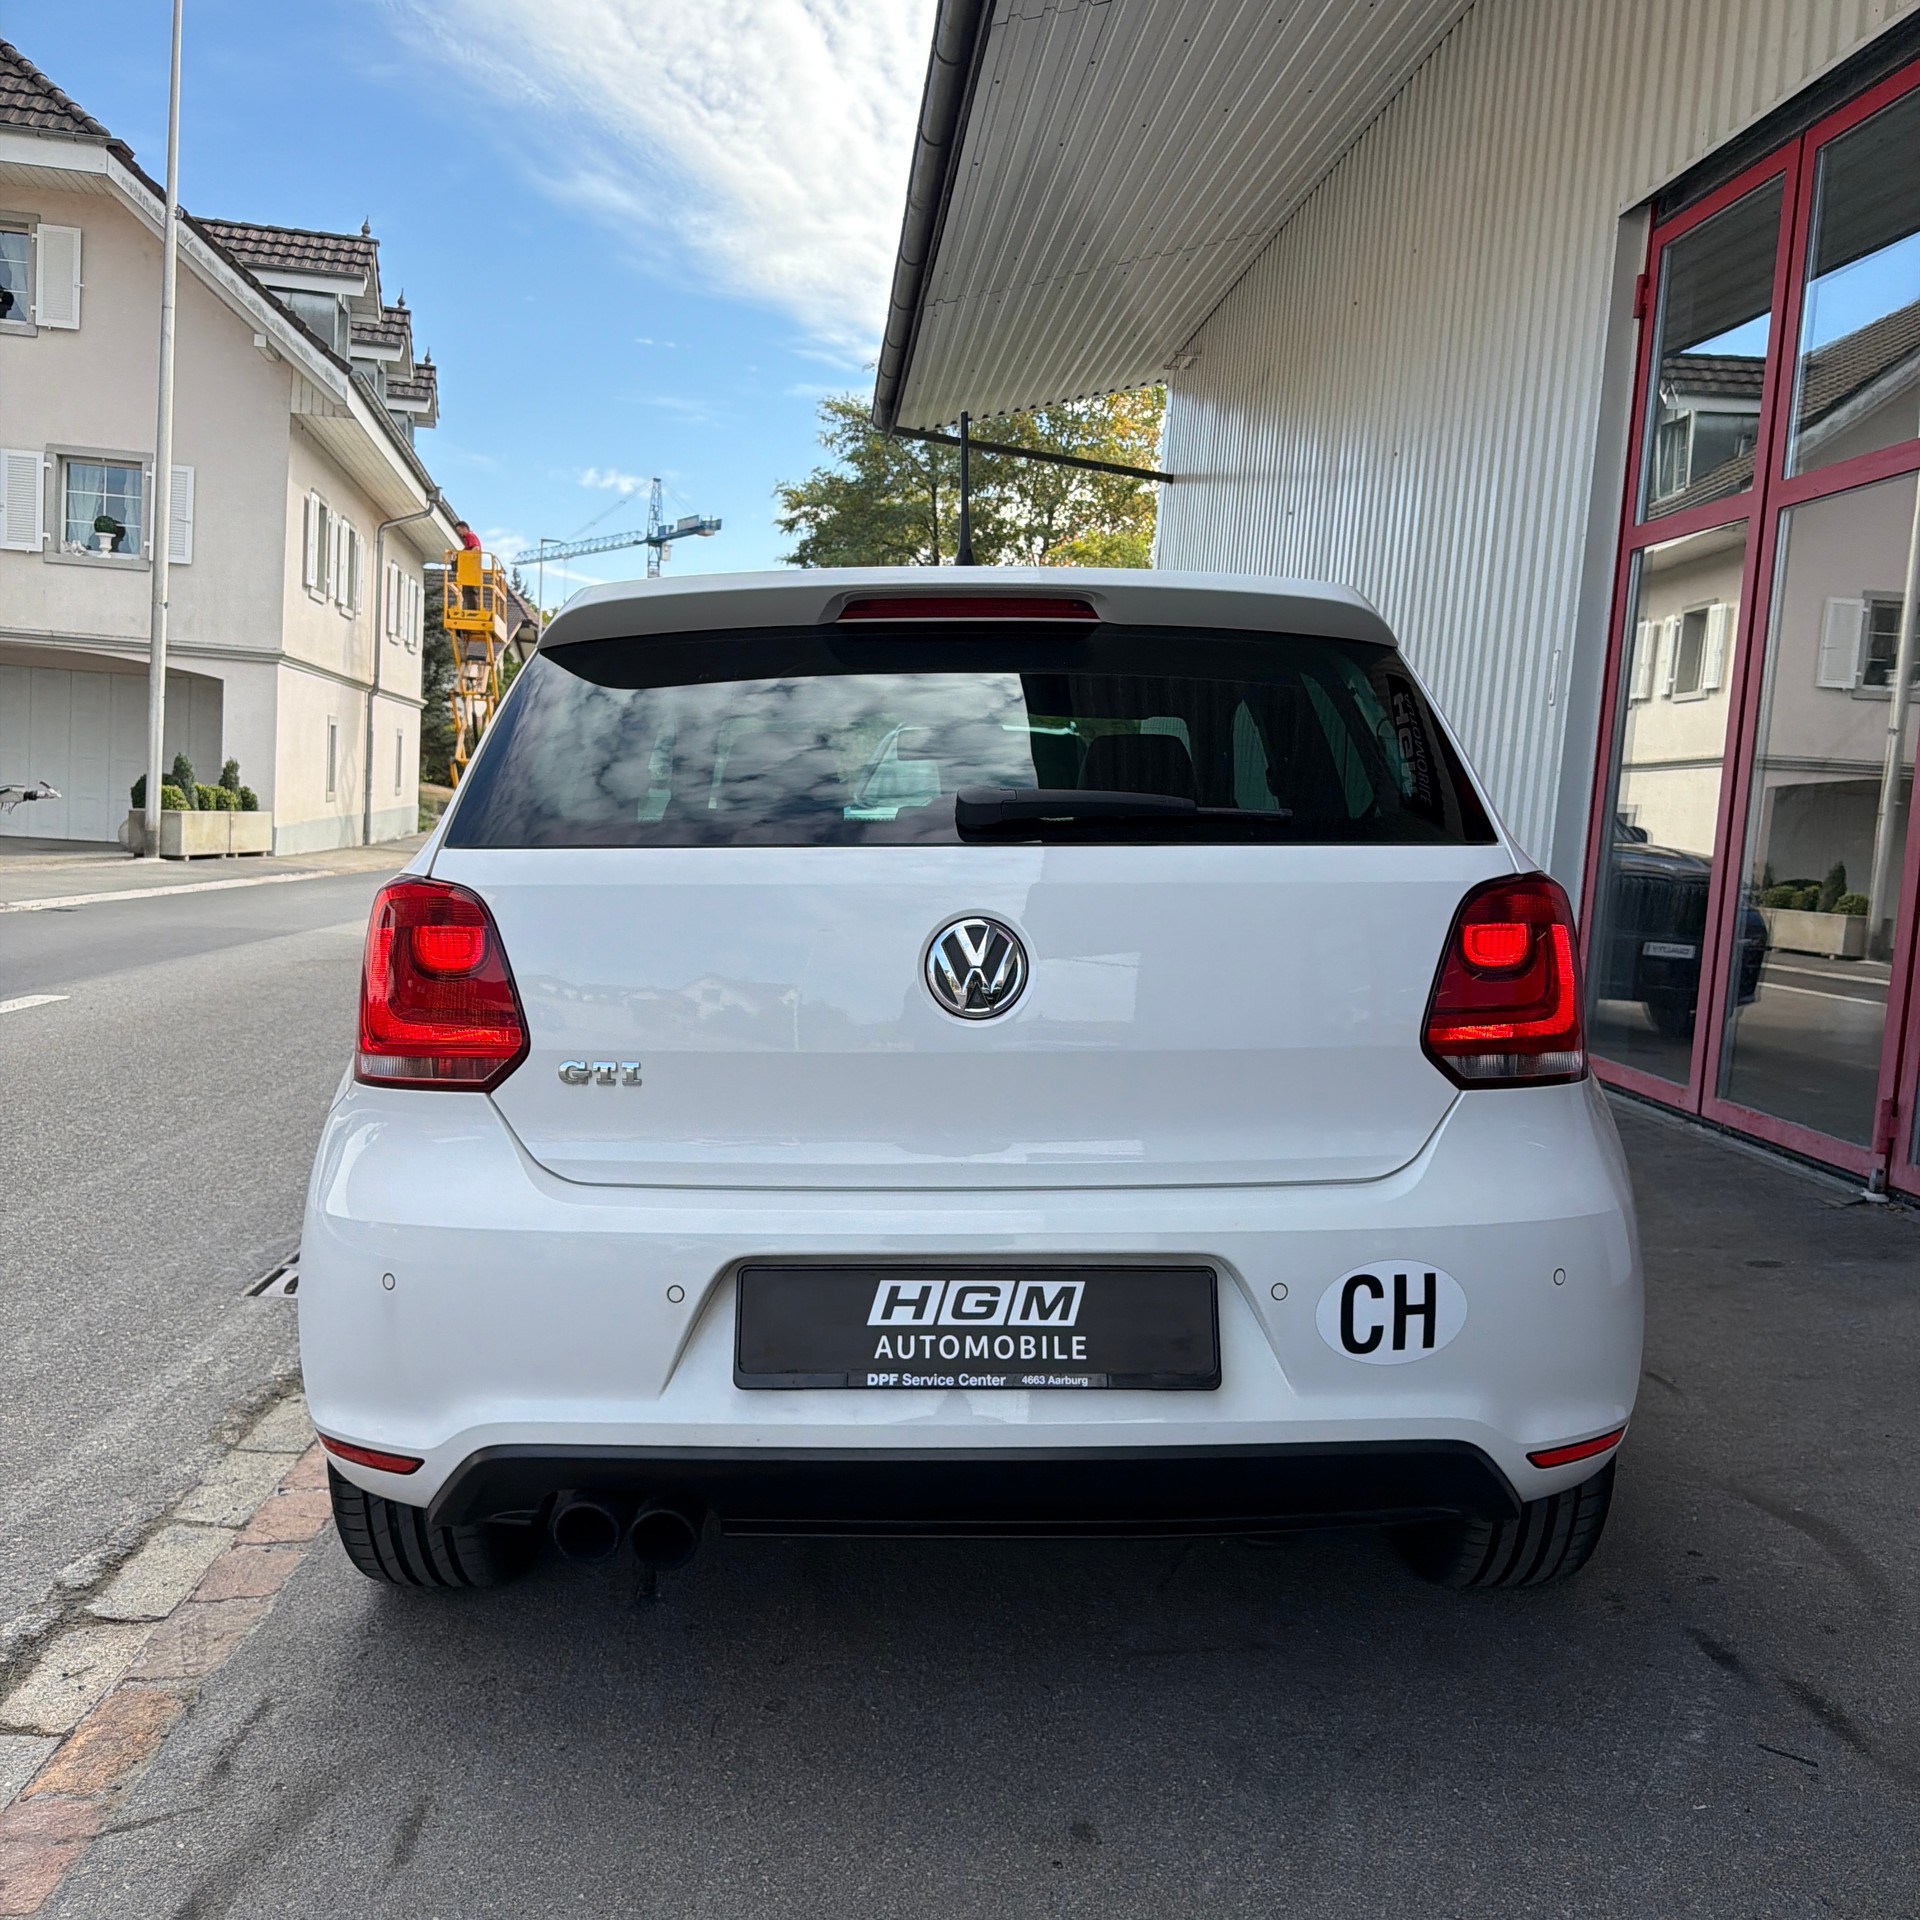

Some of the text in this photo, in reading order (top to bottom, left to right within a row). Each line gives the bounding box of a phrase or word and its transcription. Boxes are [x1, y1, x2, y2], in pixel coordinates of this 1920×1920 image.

[928, 918, 1025, 1017] VW
[558, 1060, 642, 1086] GTI
[879, 1284, 1079, 1322] HGM
[1340, 1272, 1437, 1355] CH
[874, 1334, 1087, 1360] AUTOMOBILE
[866, 1373, 1089, 1387] DPF Service Center 4663 Aarburg
